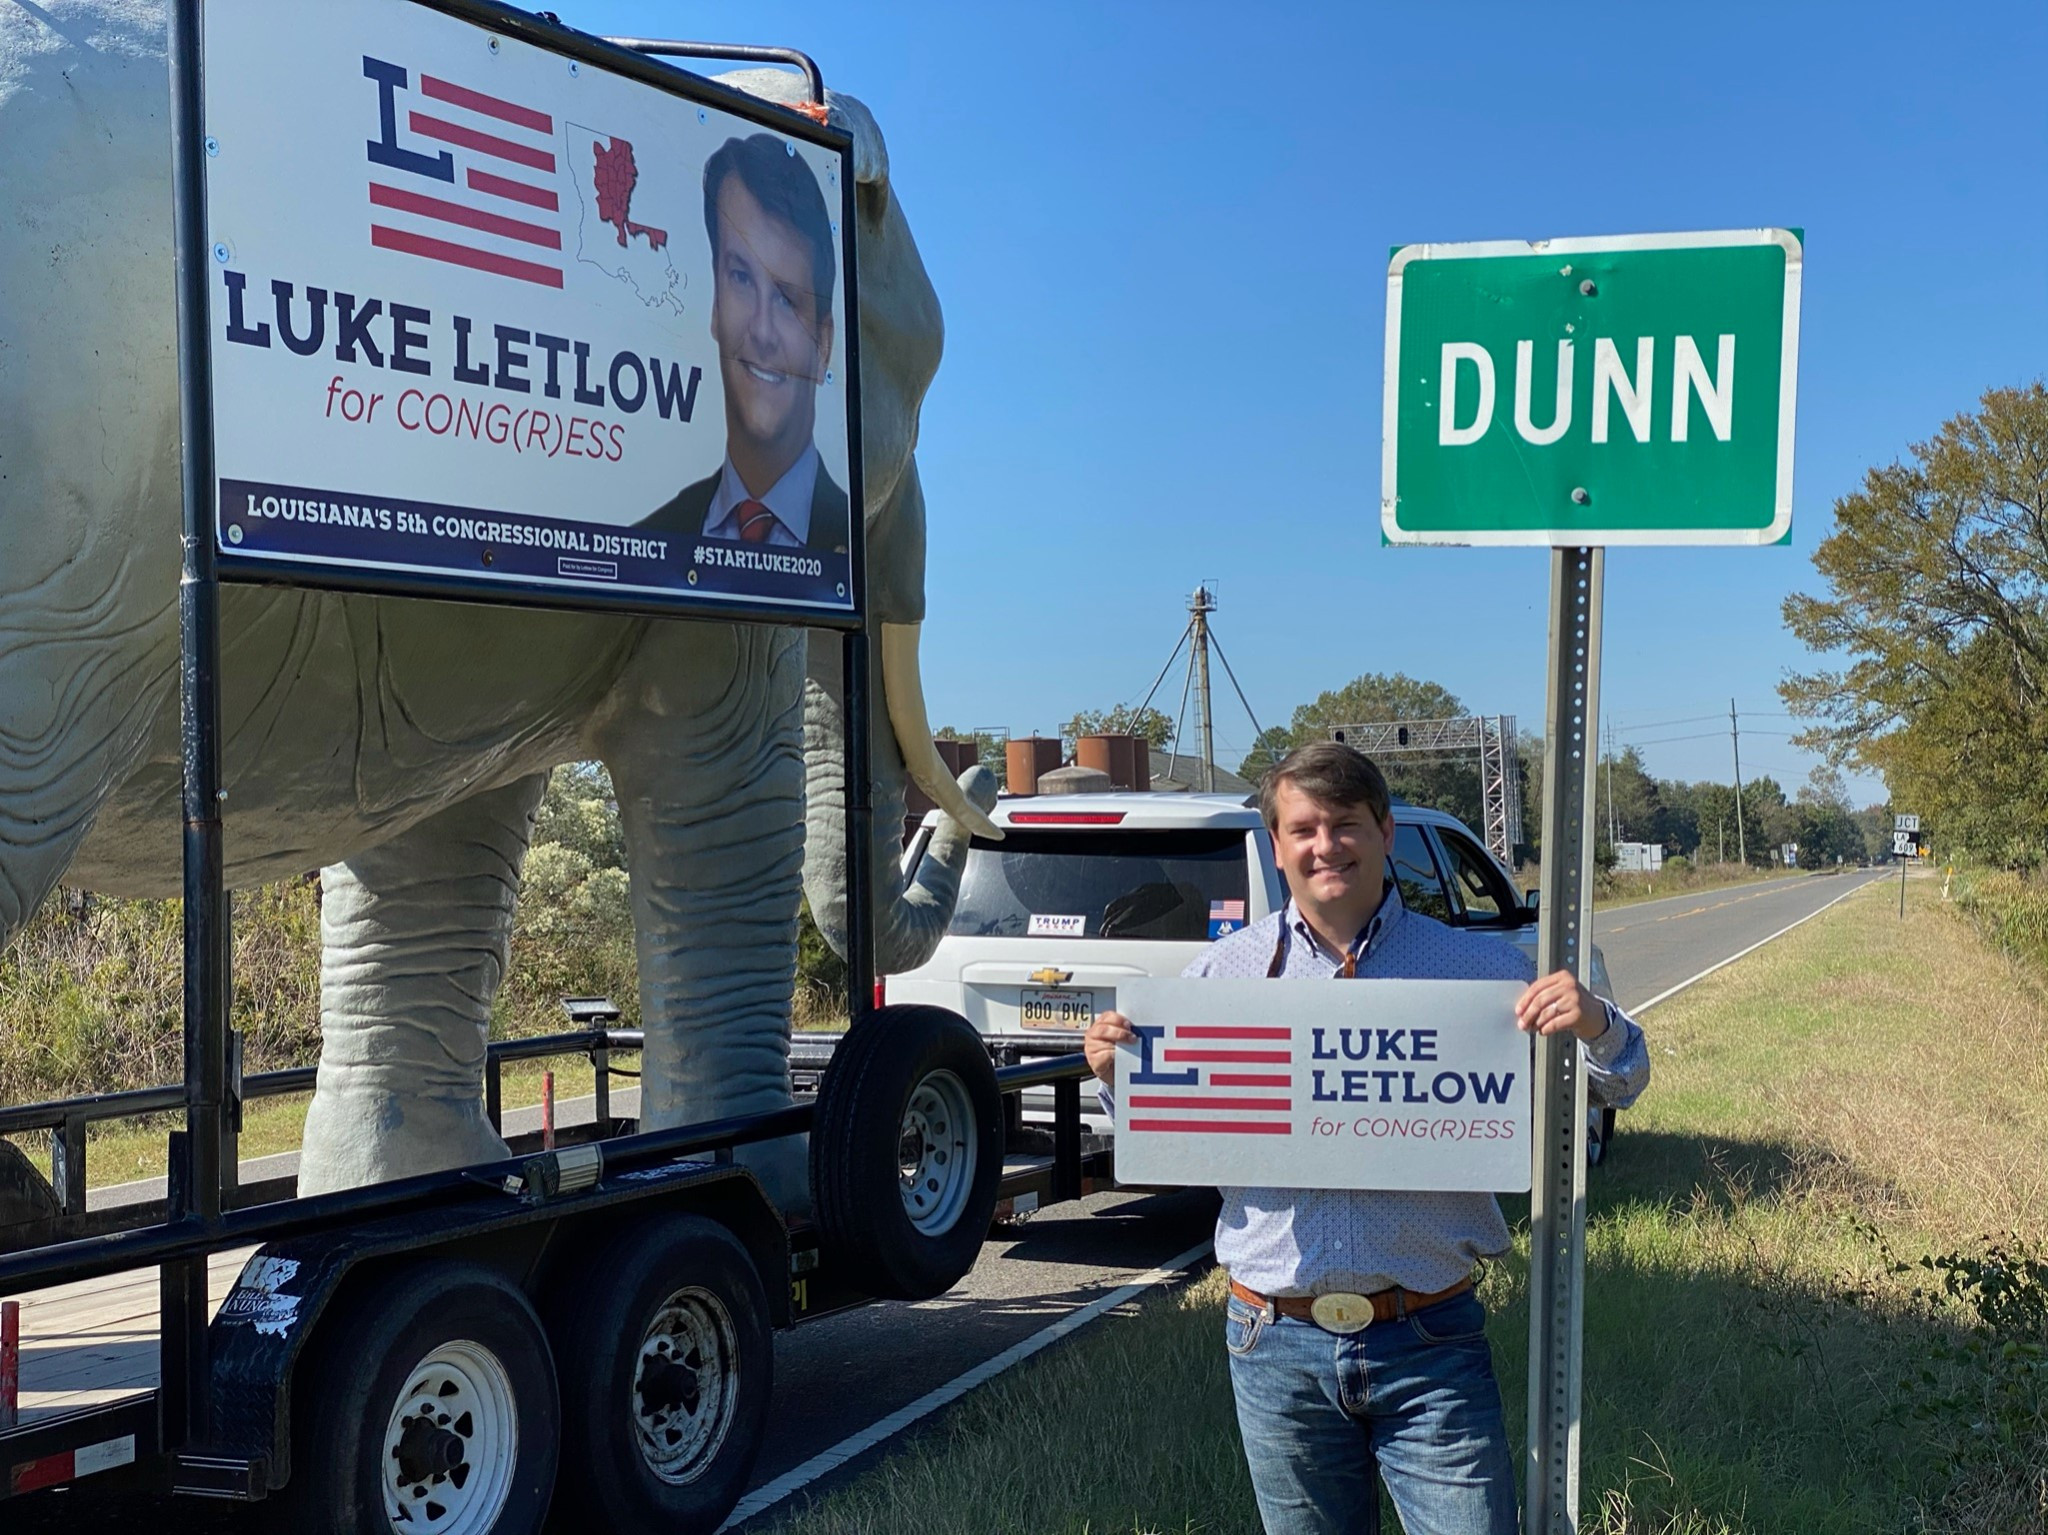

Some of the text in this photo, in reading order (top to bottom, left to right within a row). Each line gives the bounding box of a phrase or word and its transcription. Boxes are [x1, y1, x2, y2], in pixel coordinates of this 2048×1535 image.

[224, 270, 702, 423] LUKE LETLOW
[1439, 334, 1736, 446] DUNN
[325, 375, 626, 462] for CONG(R)ESS
[247, 494, 668, 560] LOUISIANA'S 5th CONGRESSIONAL DISTRICT
[694, 546, 822, 577] #STARTLUKE2020
[1896, 816, 1918, 828] JCT
[1898, 843, 1914, 852] 609
[1036, 917, 1080, 925] TRUMP
[1025, 1001, 1089, 1021] 800 BVC
[1312, 1028, 1438, 1061] LUKE
[1312, 1070, 1515, 1104] LETLOW
[1311, 1117, 1516, 1141] for CONG(R)ESS
